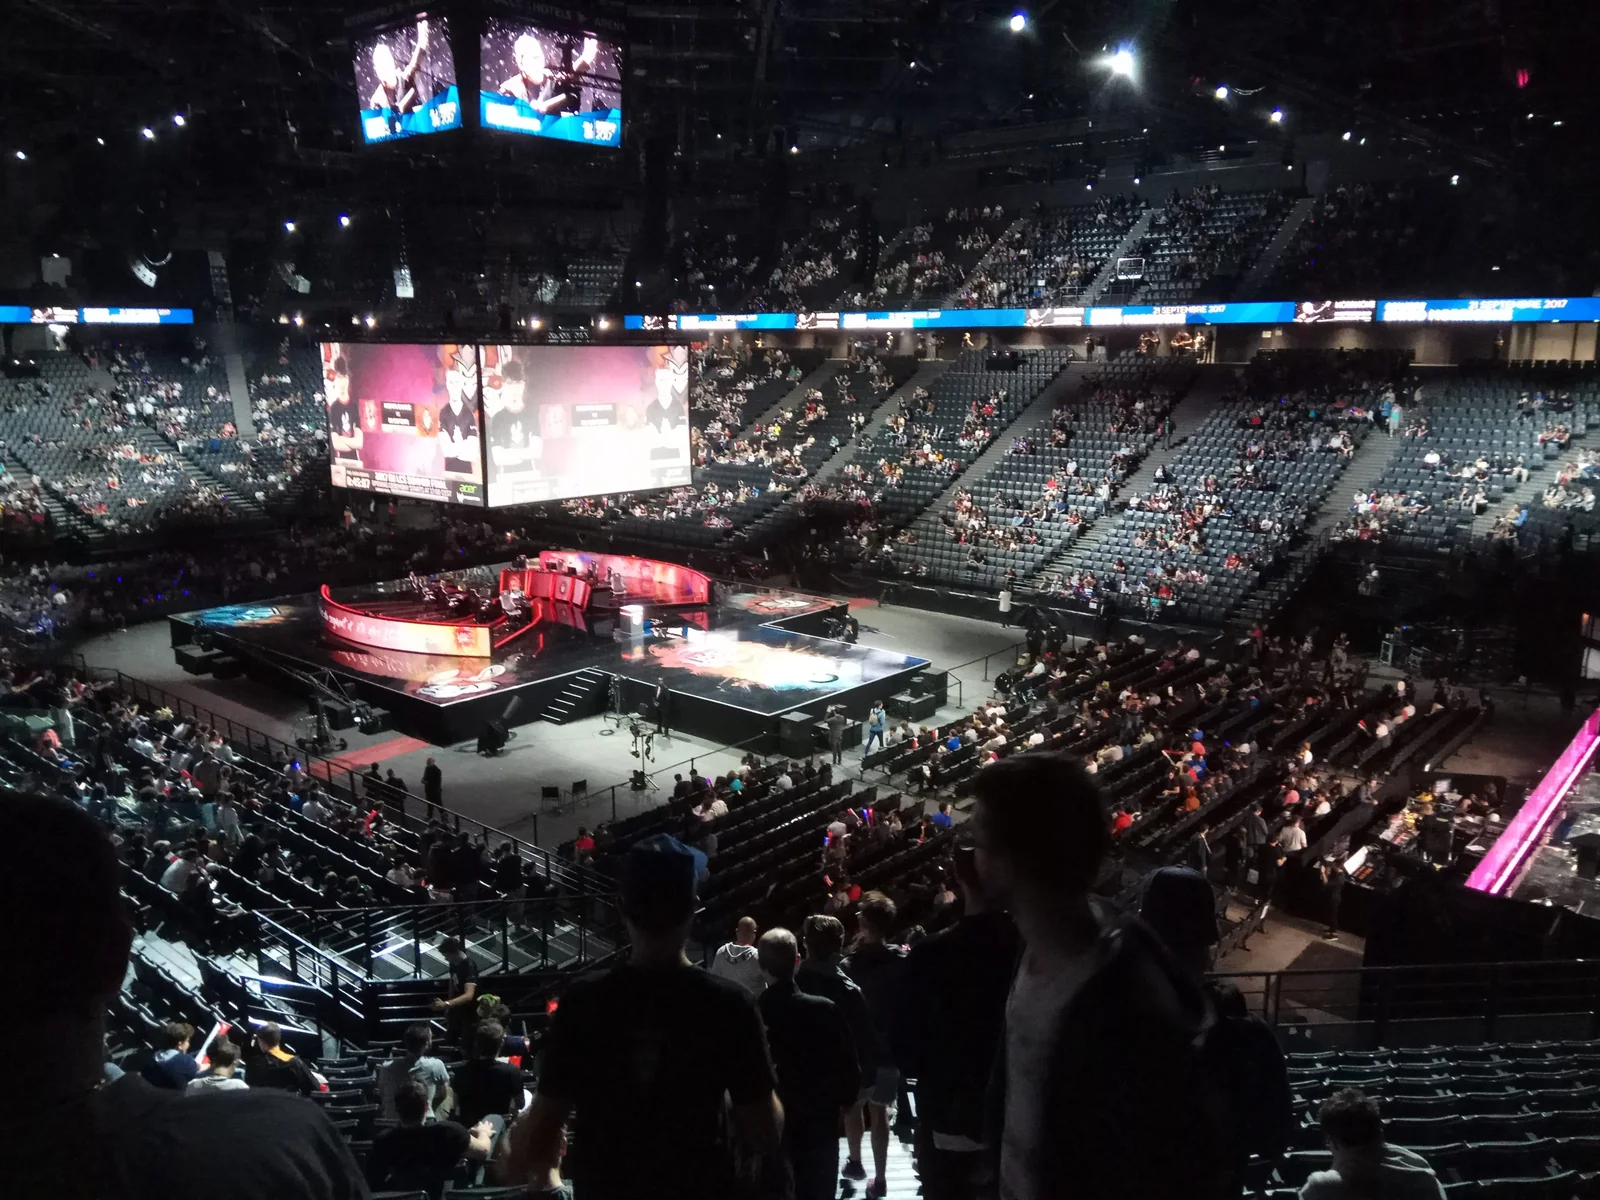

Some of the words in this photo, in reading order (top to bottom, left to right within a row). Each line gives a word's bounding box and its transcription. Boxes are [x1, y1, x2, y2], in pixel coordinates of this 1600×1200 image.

[1543, 299, 1568, 308] 2017
[1208, 305, 1226, 313] 2017
[459, 484, 477, 493] acer
